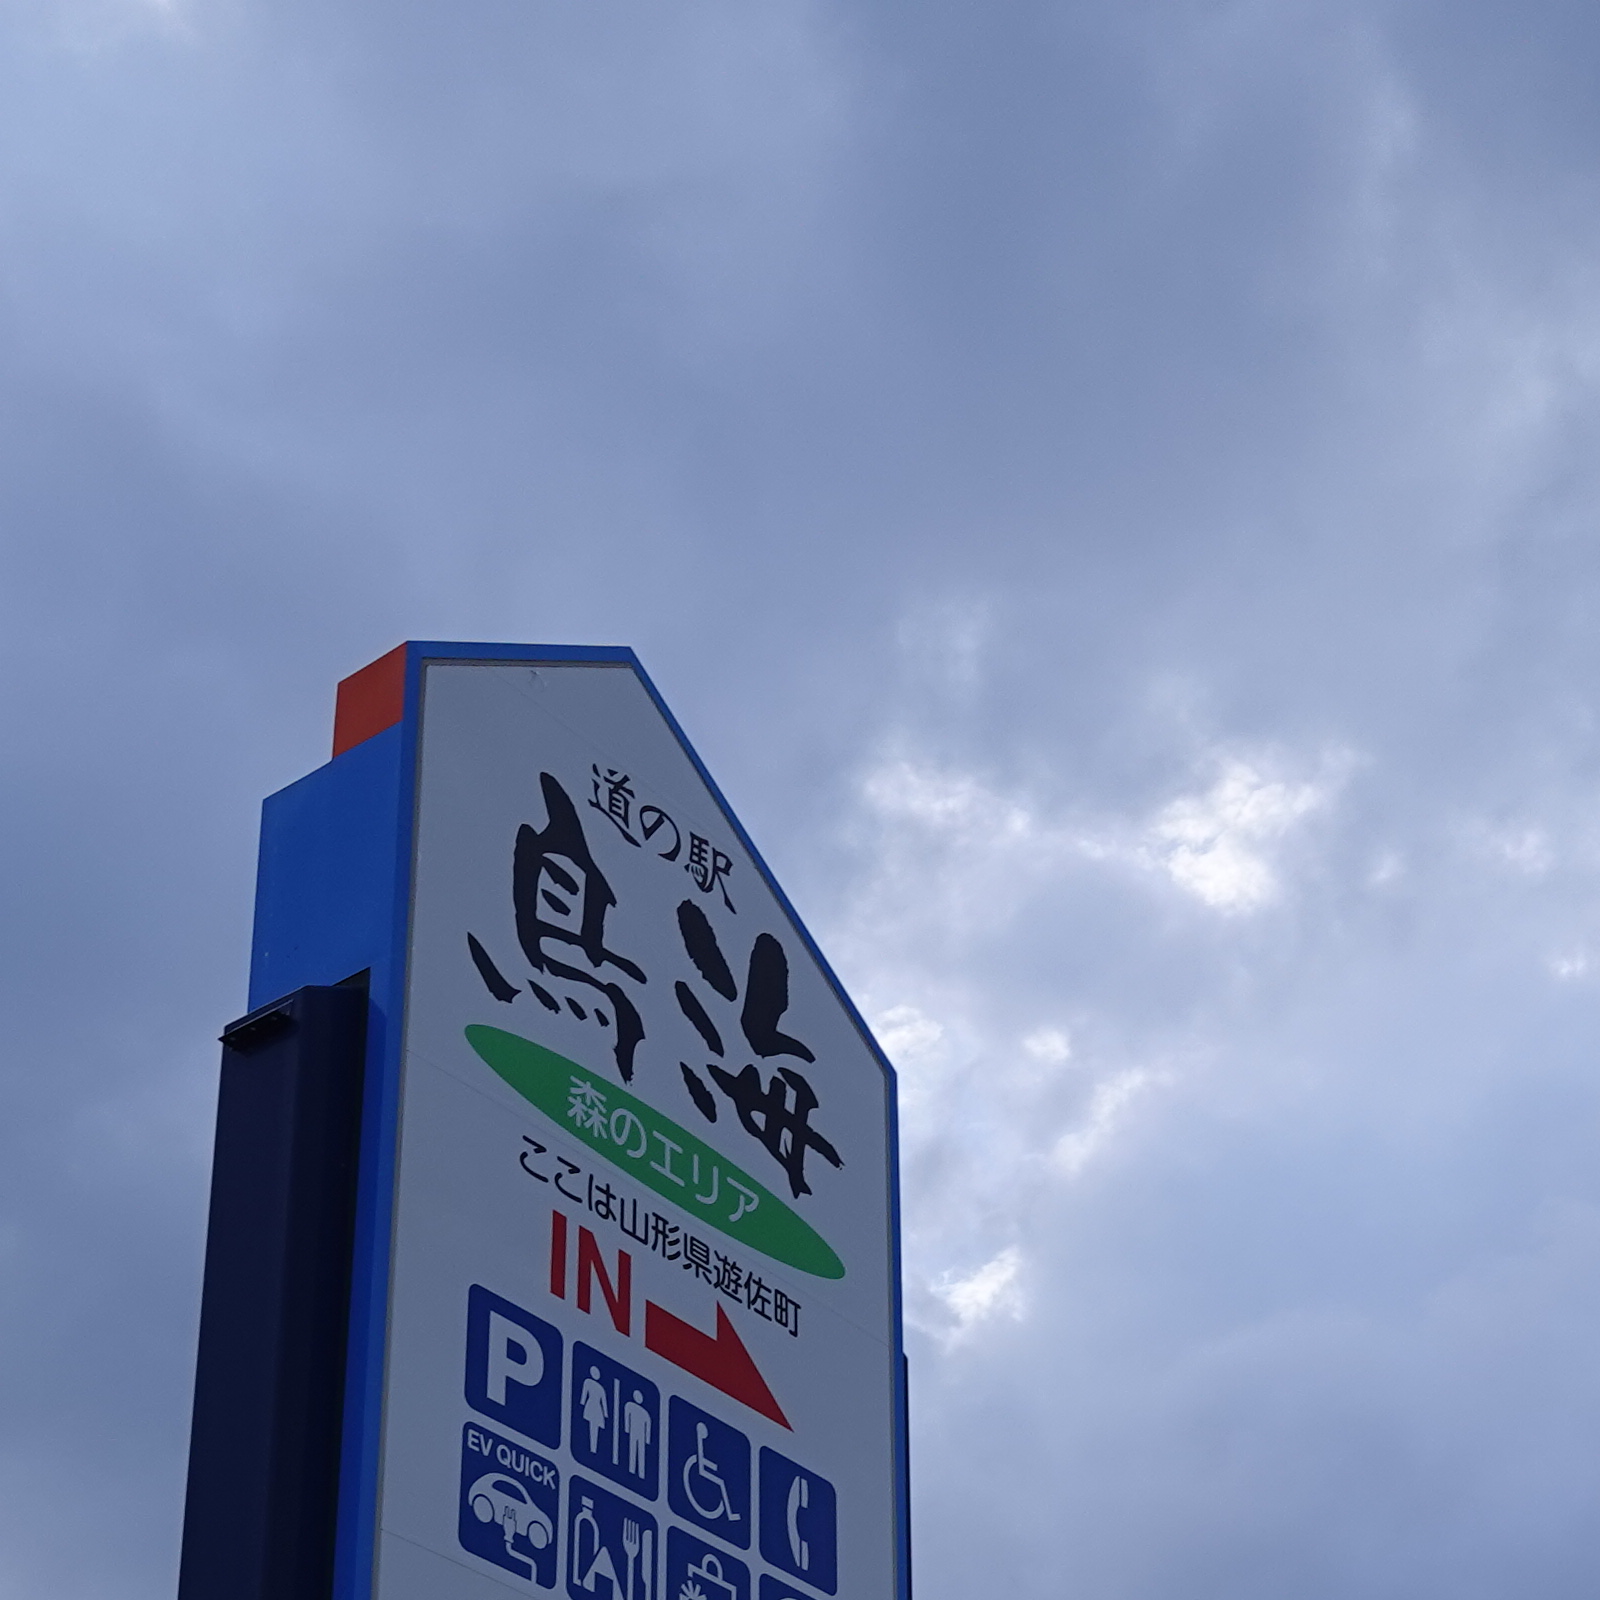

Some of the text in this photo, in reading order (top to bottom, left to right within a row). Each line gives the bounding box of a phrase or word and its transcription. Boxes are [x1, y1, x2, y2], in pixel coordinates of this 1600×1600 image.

[588, 763, 737, 915] 道の駅
[467, 771, 845, 1199] 鳥海
[565, 1074, 761, 1222] 森のエリア
[519, 1135, 802, 1338] ここは山形県遊佐町
[549, 1209, 632, 1338] IN
[486, 1309, 545, 1406] P
[467, 1428, 557, 1490] EV QUICK
